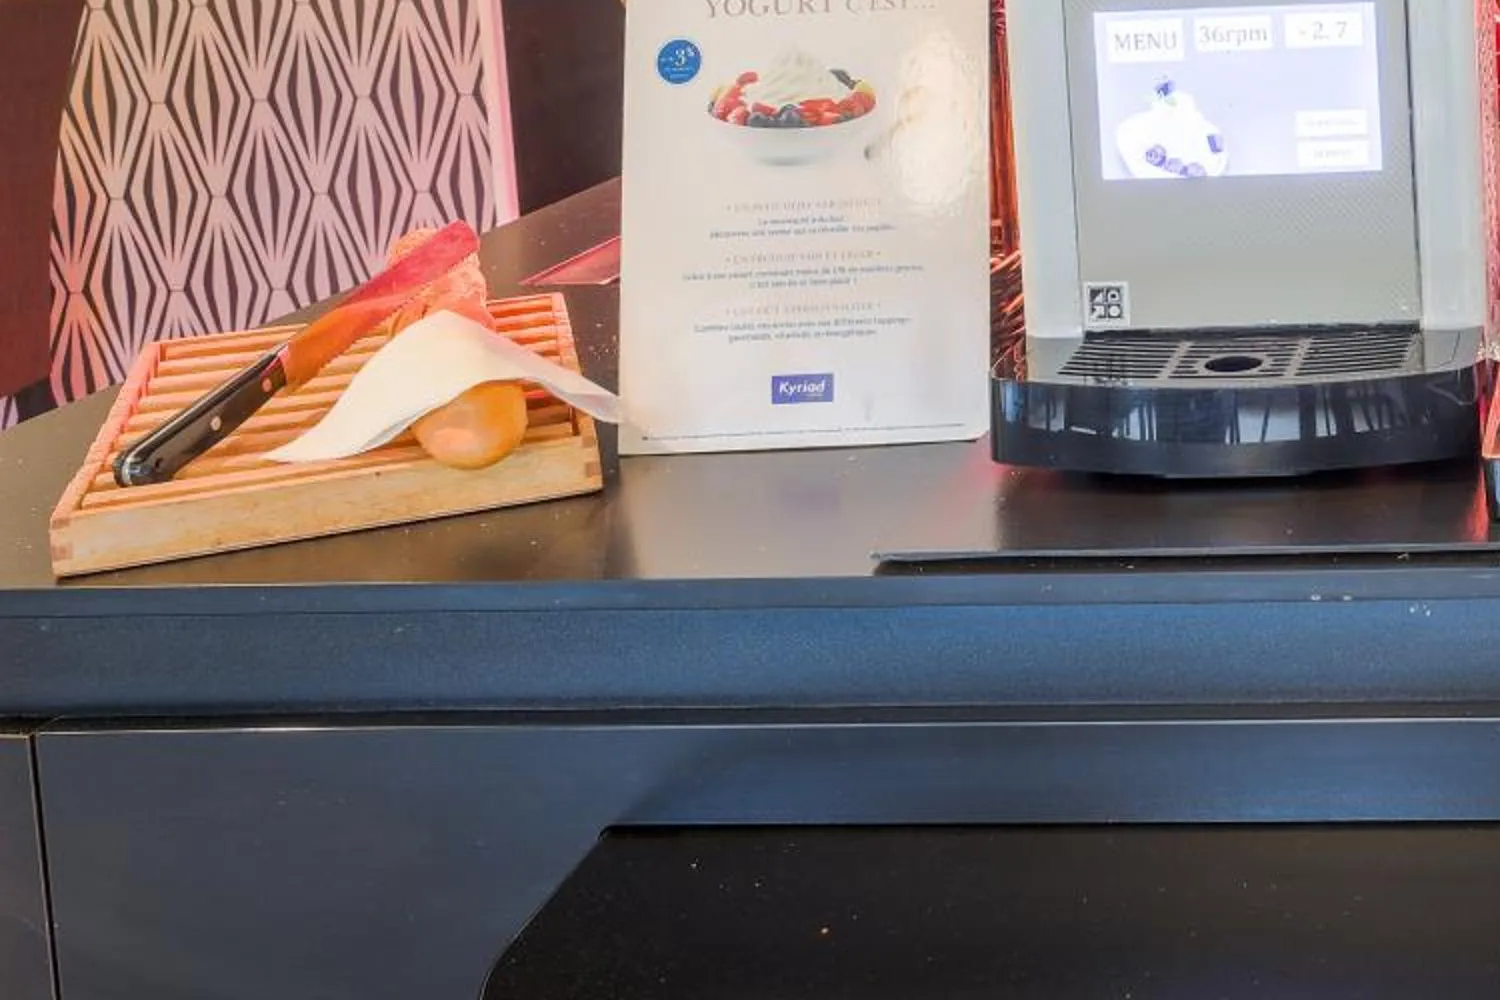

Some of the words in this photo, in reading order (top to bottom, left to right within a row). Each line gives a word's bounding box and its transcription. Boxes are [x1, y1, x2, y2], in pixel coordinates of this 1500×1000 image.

[1113, 31, 1177, 51] MENU
[1199, 24, 1267, 47] 36rpm
[780, 380, 825, 396] Kyriad
